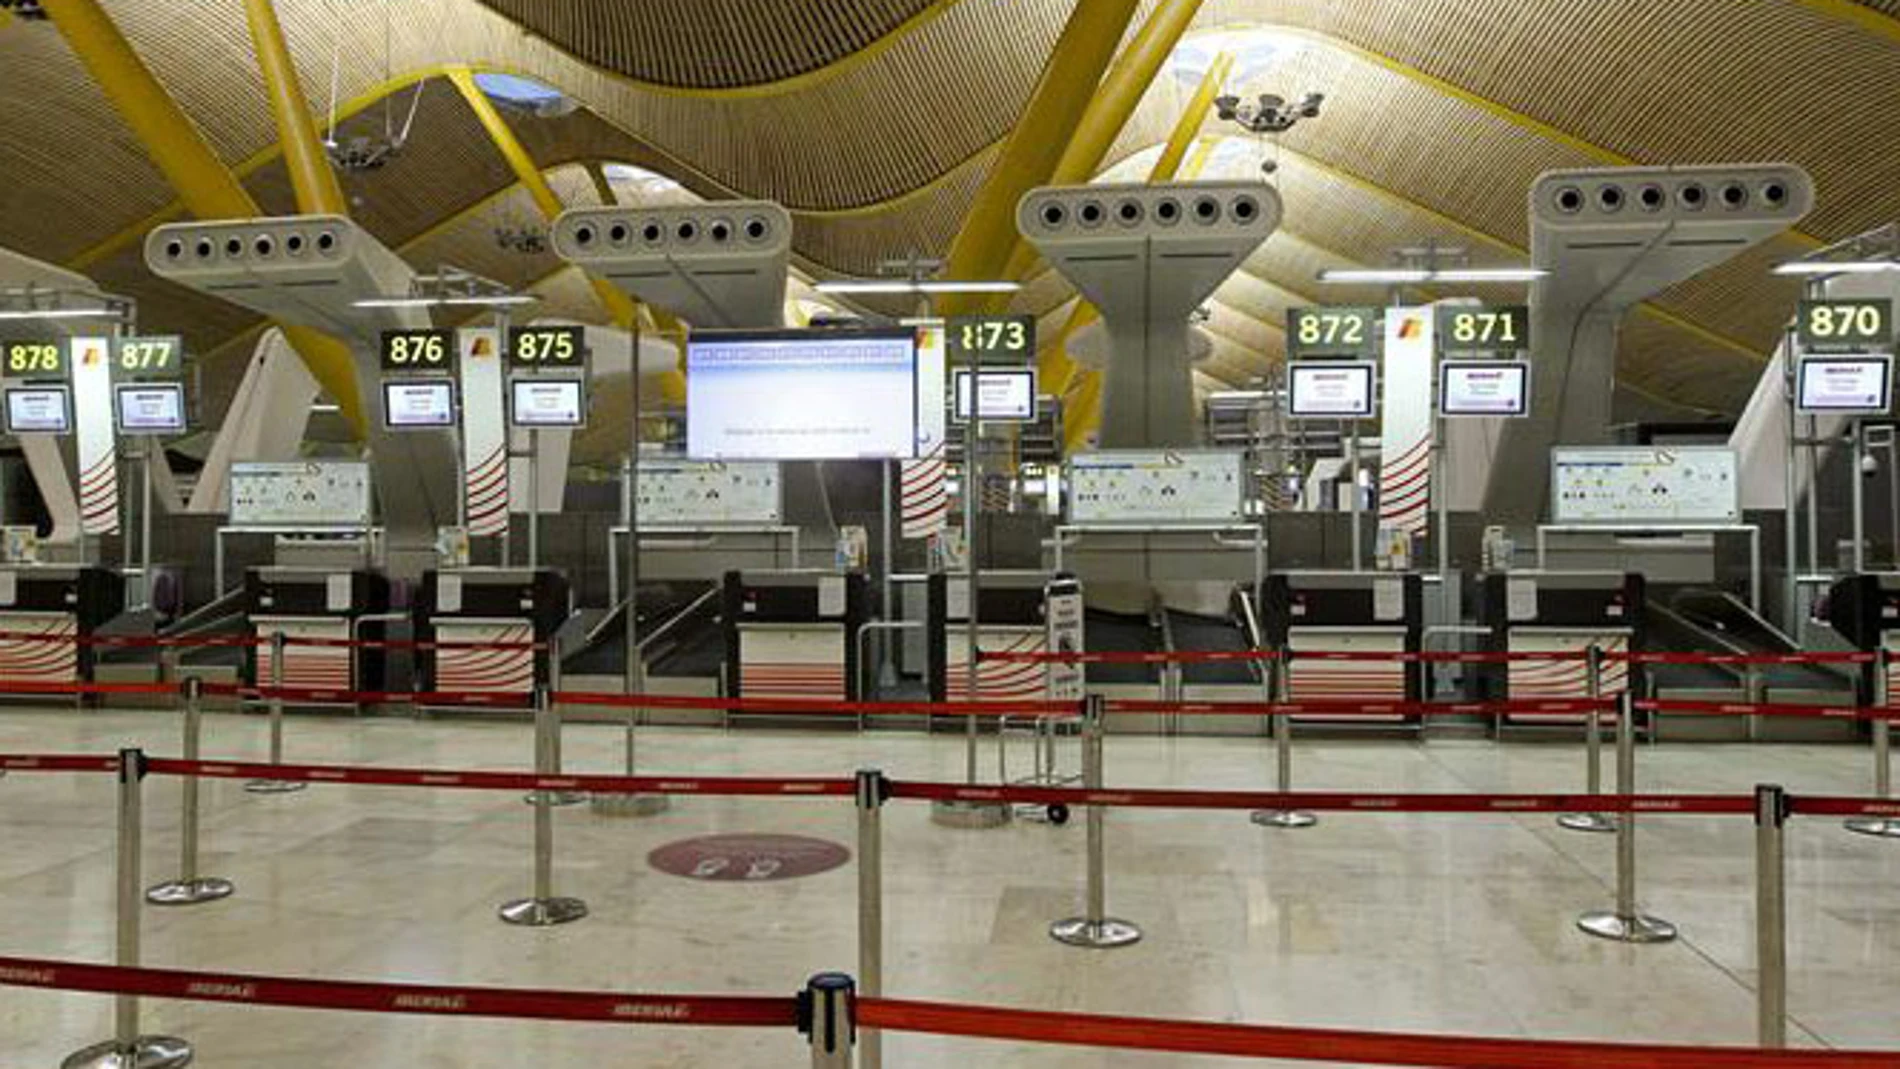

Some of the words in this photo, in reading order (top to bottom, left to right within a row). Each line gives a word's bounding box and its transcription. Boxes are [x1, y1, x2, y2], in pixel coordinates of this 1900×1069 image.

[1298, 314, 1363, 343] 872
[1453, 313, 1516, 342] 871
[1810, 305, 1881, 336] 870
[10, 345, 58, 370] 878
[122, 342, 171, 369] 877
[391, 336, 443, 363] 876
[518, 332, 573, 359] 875
